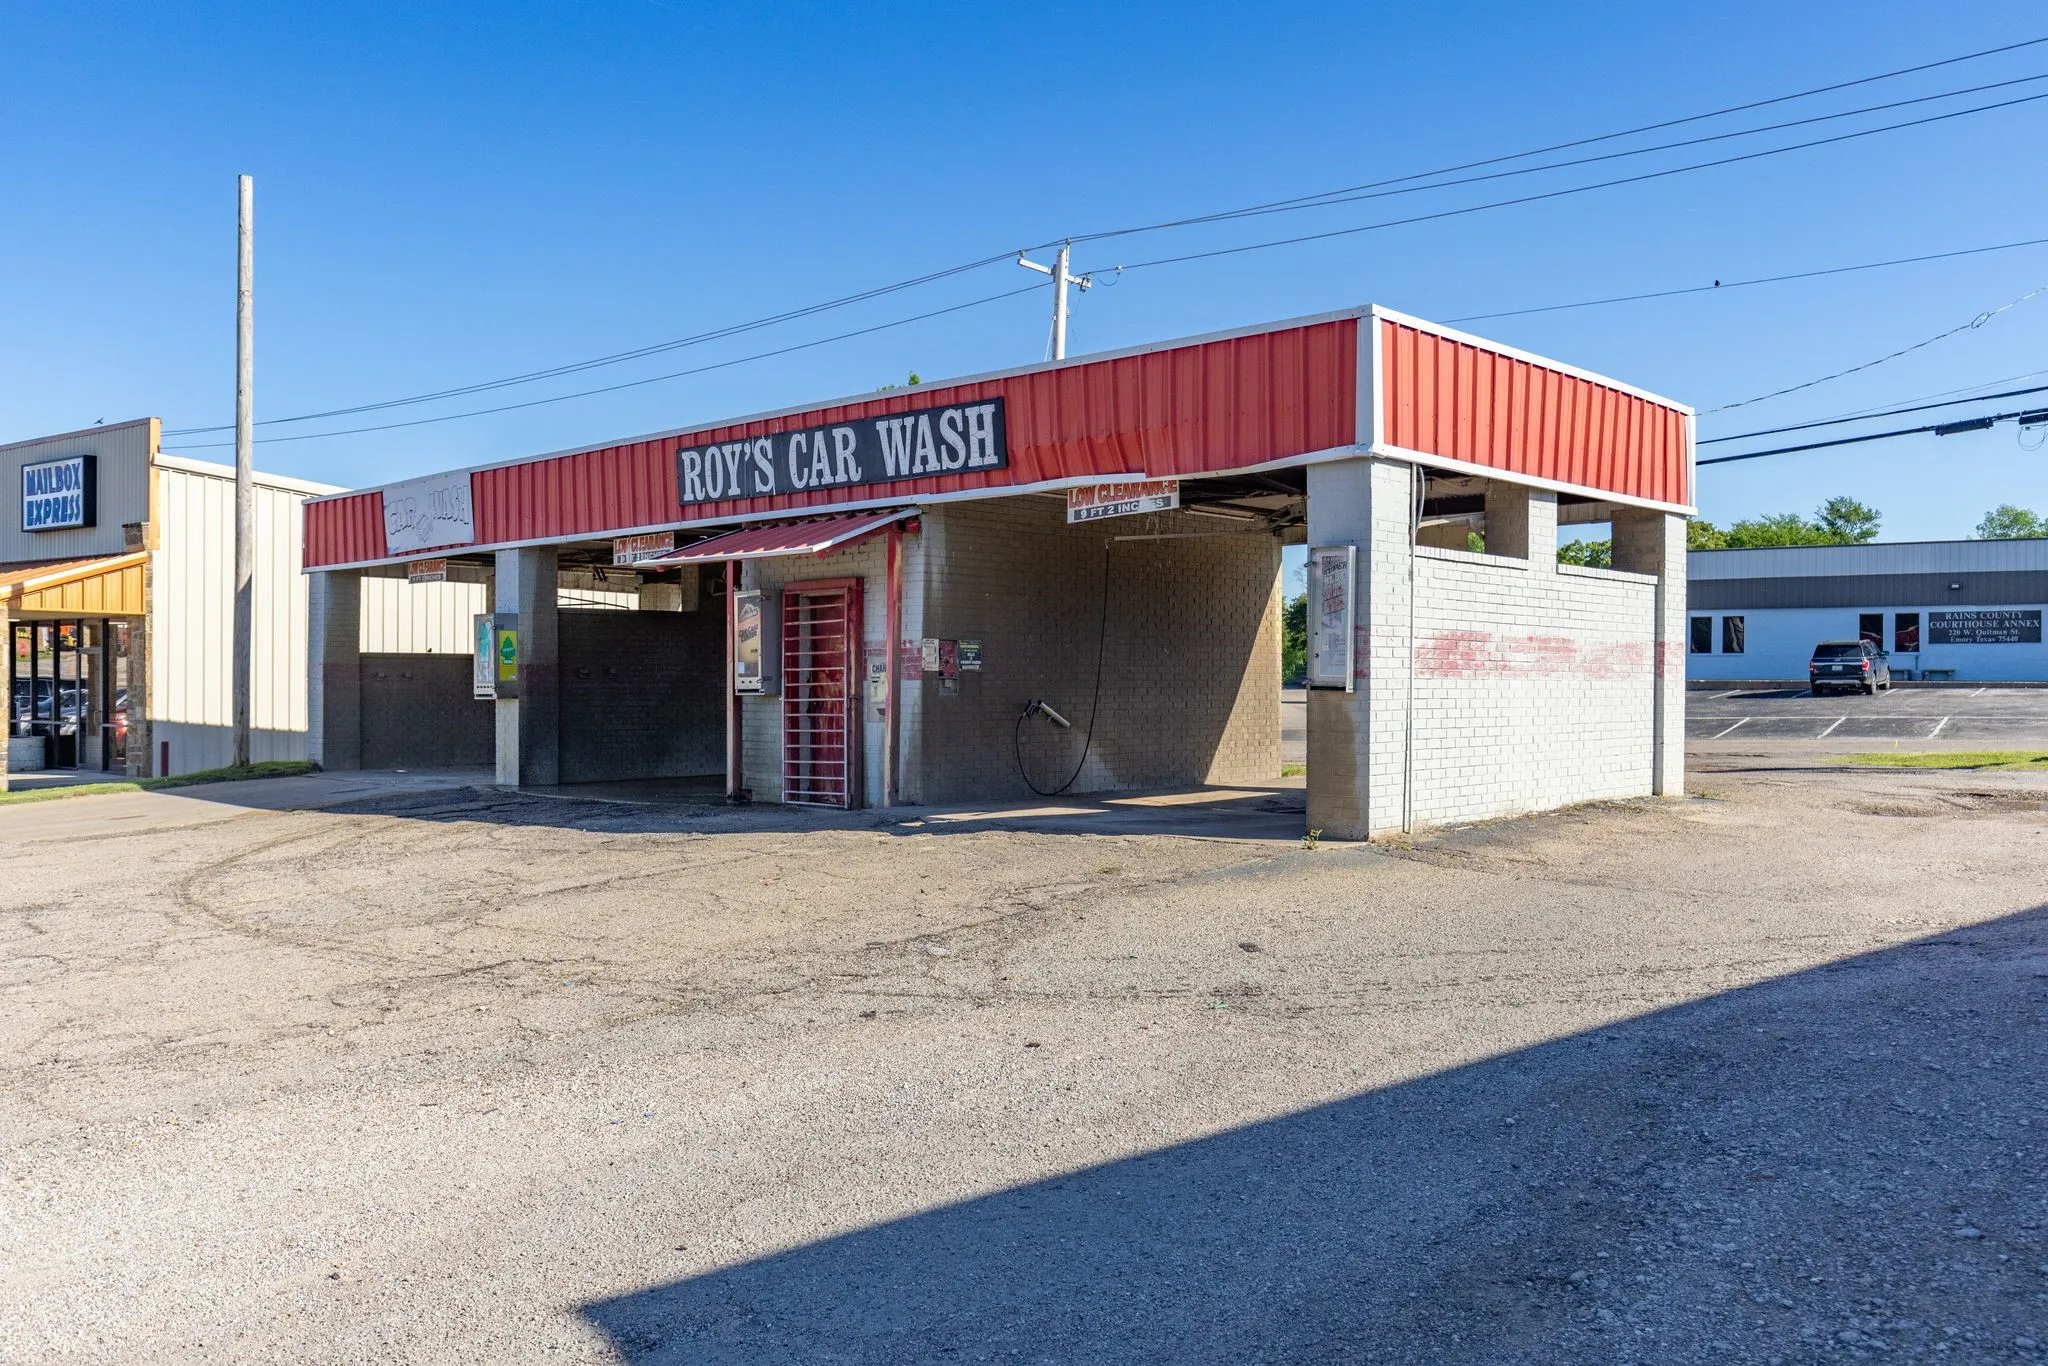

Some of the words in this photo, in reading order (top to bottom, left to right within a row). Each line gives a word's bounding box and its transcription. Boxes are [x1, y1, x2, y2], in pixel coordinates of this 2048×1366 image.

[681, 435, 775, 501] ROY'S
[788, 427, 862, 489] CAR
[875, 404, 998, 477] WASH
[26, 463, 81, 496] MAILBOX
[429, 485, 469, 525] WASH
[1068, 486, 1096, 509] LOW
[1097, 480, 1178, 504] CLEARANCE
[26, 494, 81, 527] EXPRESS
[1080, 508, 1087, 519] 9
[1090, 507, 1105, 517] FT
[1107, 506, 1114, 514] 2
[1117, 498, 1164, 513] INCES
[615, 538, 630, 555] LOW
[1930, 620, 1999, 628] COURTHOUSE
[2002, 619, 2040, 628] ANNEX
[1945, 612, 1977, 620] RAINS
[1980, 611, 2024, 619] COUNTY
[1975, 629, 2008, 637] Quitman
[872, 664, 887, 674] CHAN
